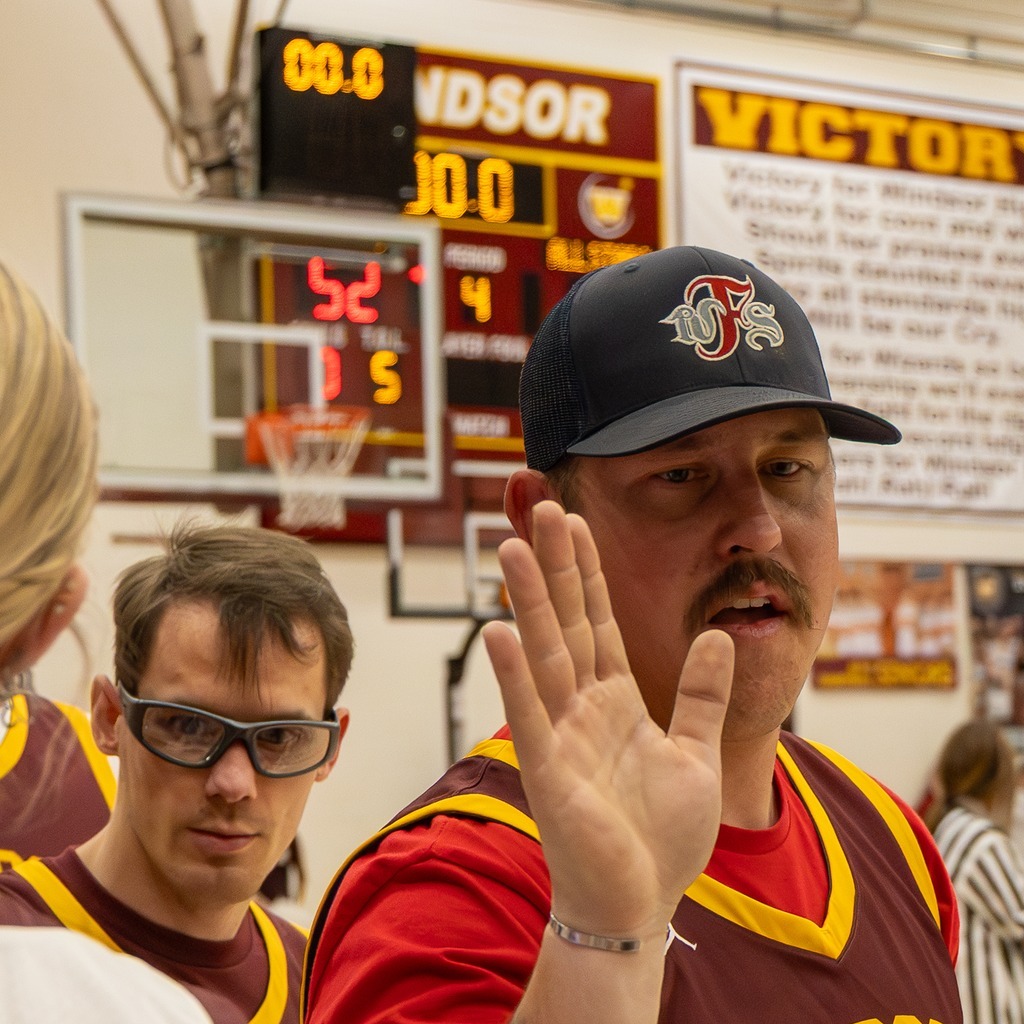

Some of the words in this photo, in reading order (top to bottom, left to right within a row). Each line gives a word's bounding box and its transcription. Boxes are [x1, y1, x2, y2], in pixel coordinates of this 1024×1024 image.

[283, 38, 385, 100] 00.0
[460, 276, 492, 323] 4
[370, 350, 402, 404] 5
